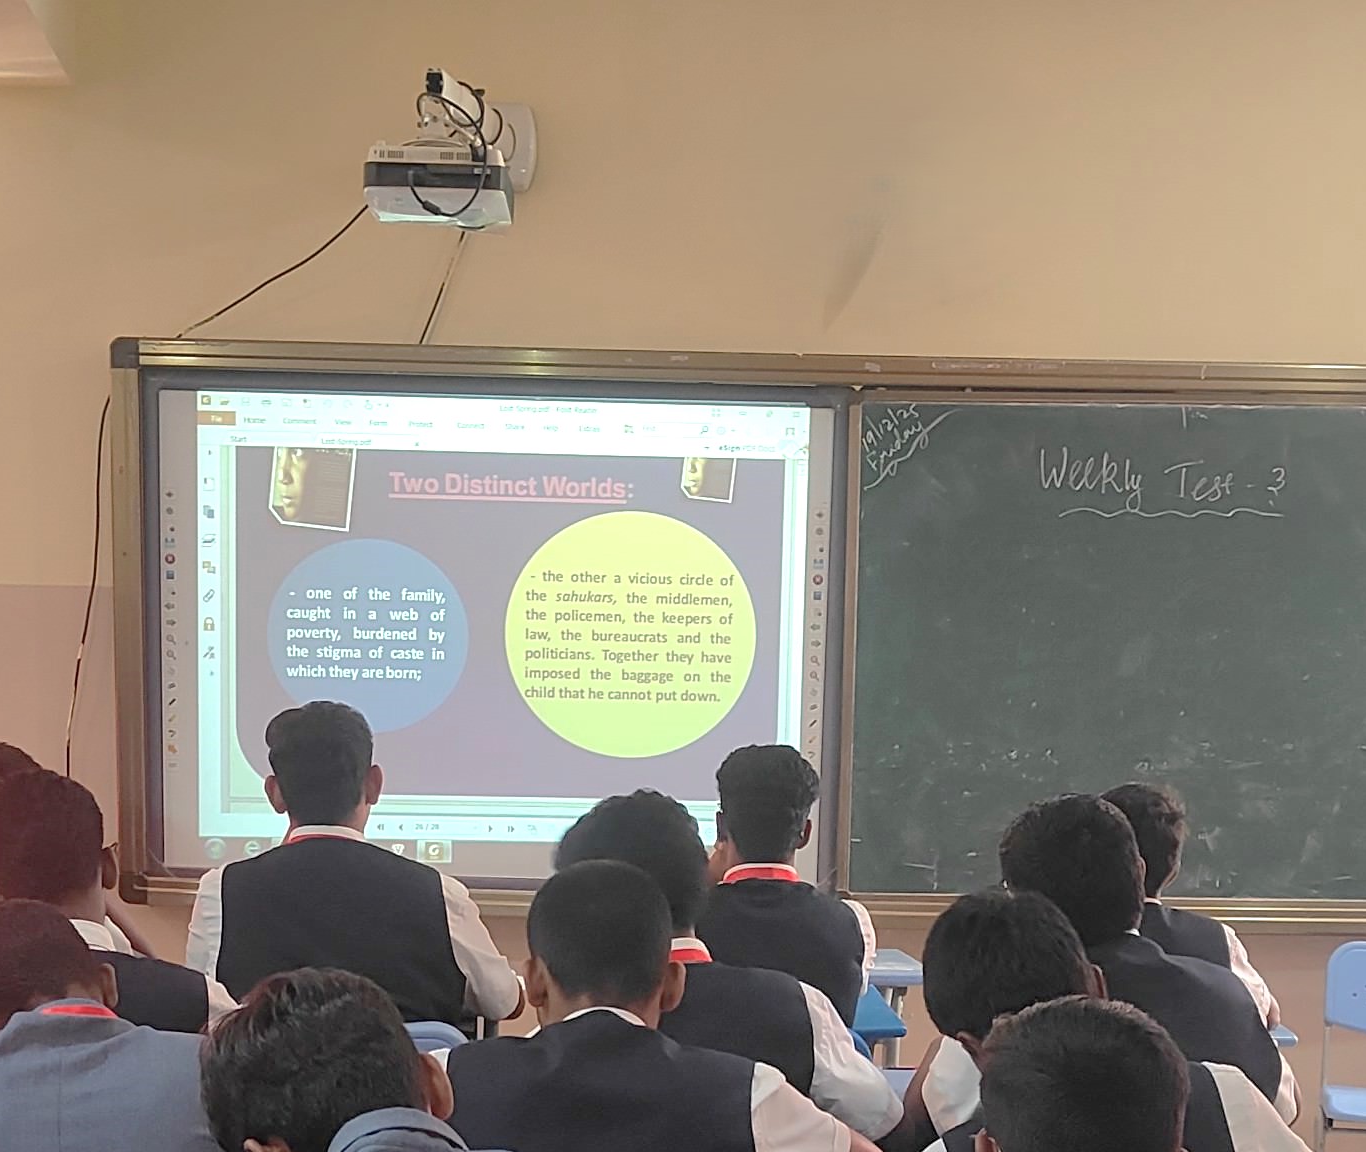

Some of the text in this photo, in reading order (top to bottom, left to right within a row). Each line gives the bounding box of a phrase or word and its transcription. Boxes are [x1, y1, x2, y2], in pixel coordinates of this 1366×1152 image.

[388, 471, 634, 499] Two Distinct Worlds:
[1040, 446, 1143, 513] Weekly
[1163, 459, 1233, 501] Test
[542, 570, 564, 583] the
[571, 572, 607, 583] other
[614, 575, 621, 583] a
[628, 573, 672, 585] vicious
[679, 574, 713, 585] circle
[720, 574, 735, 586] of
[306, 589, 332, 600] one
[343, 587, 358, 600] of
[368, 588, 391, 601] the
[401, 588, 446, 604] family,
[526, 590, 733, 607] the sahukars, the middlemen,
[287, 606, 445, 621] caught in a web of
[526, 609, 734, 626] the policemen, the keepers of
[287, 627, 445, 644] poverty, burdened by
[525, 629, 731, 644] law, the bureaucrats and the
[287, 645, 444, 660] the stigma of caste in
[525, 648, 731, 665] politicians. Together they have
[287, 665, 422, 681] which they are born;
[525, 667, 731, 684] imposed the baggage on the
[525, 687, 721, 703] child that he cannot put down.
